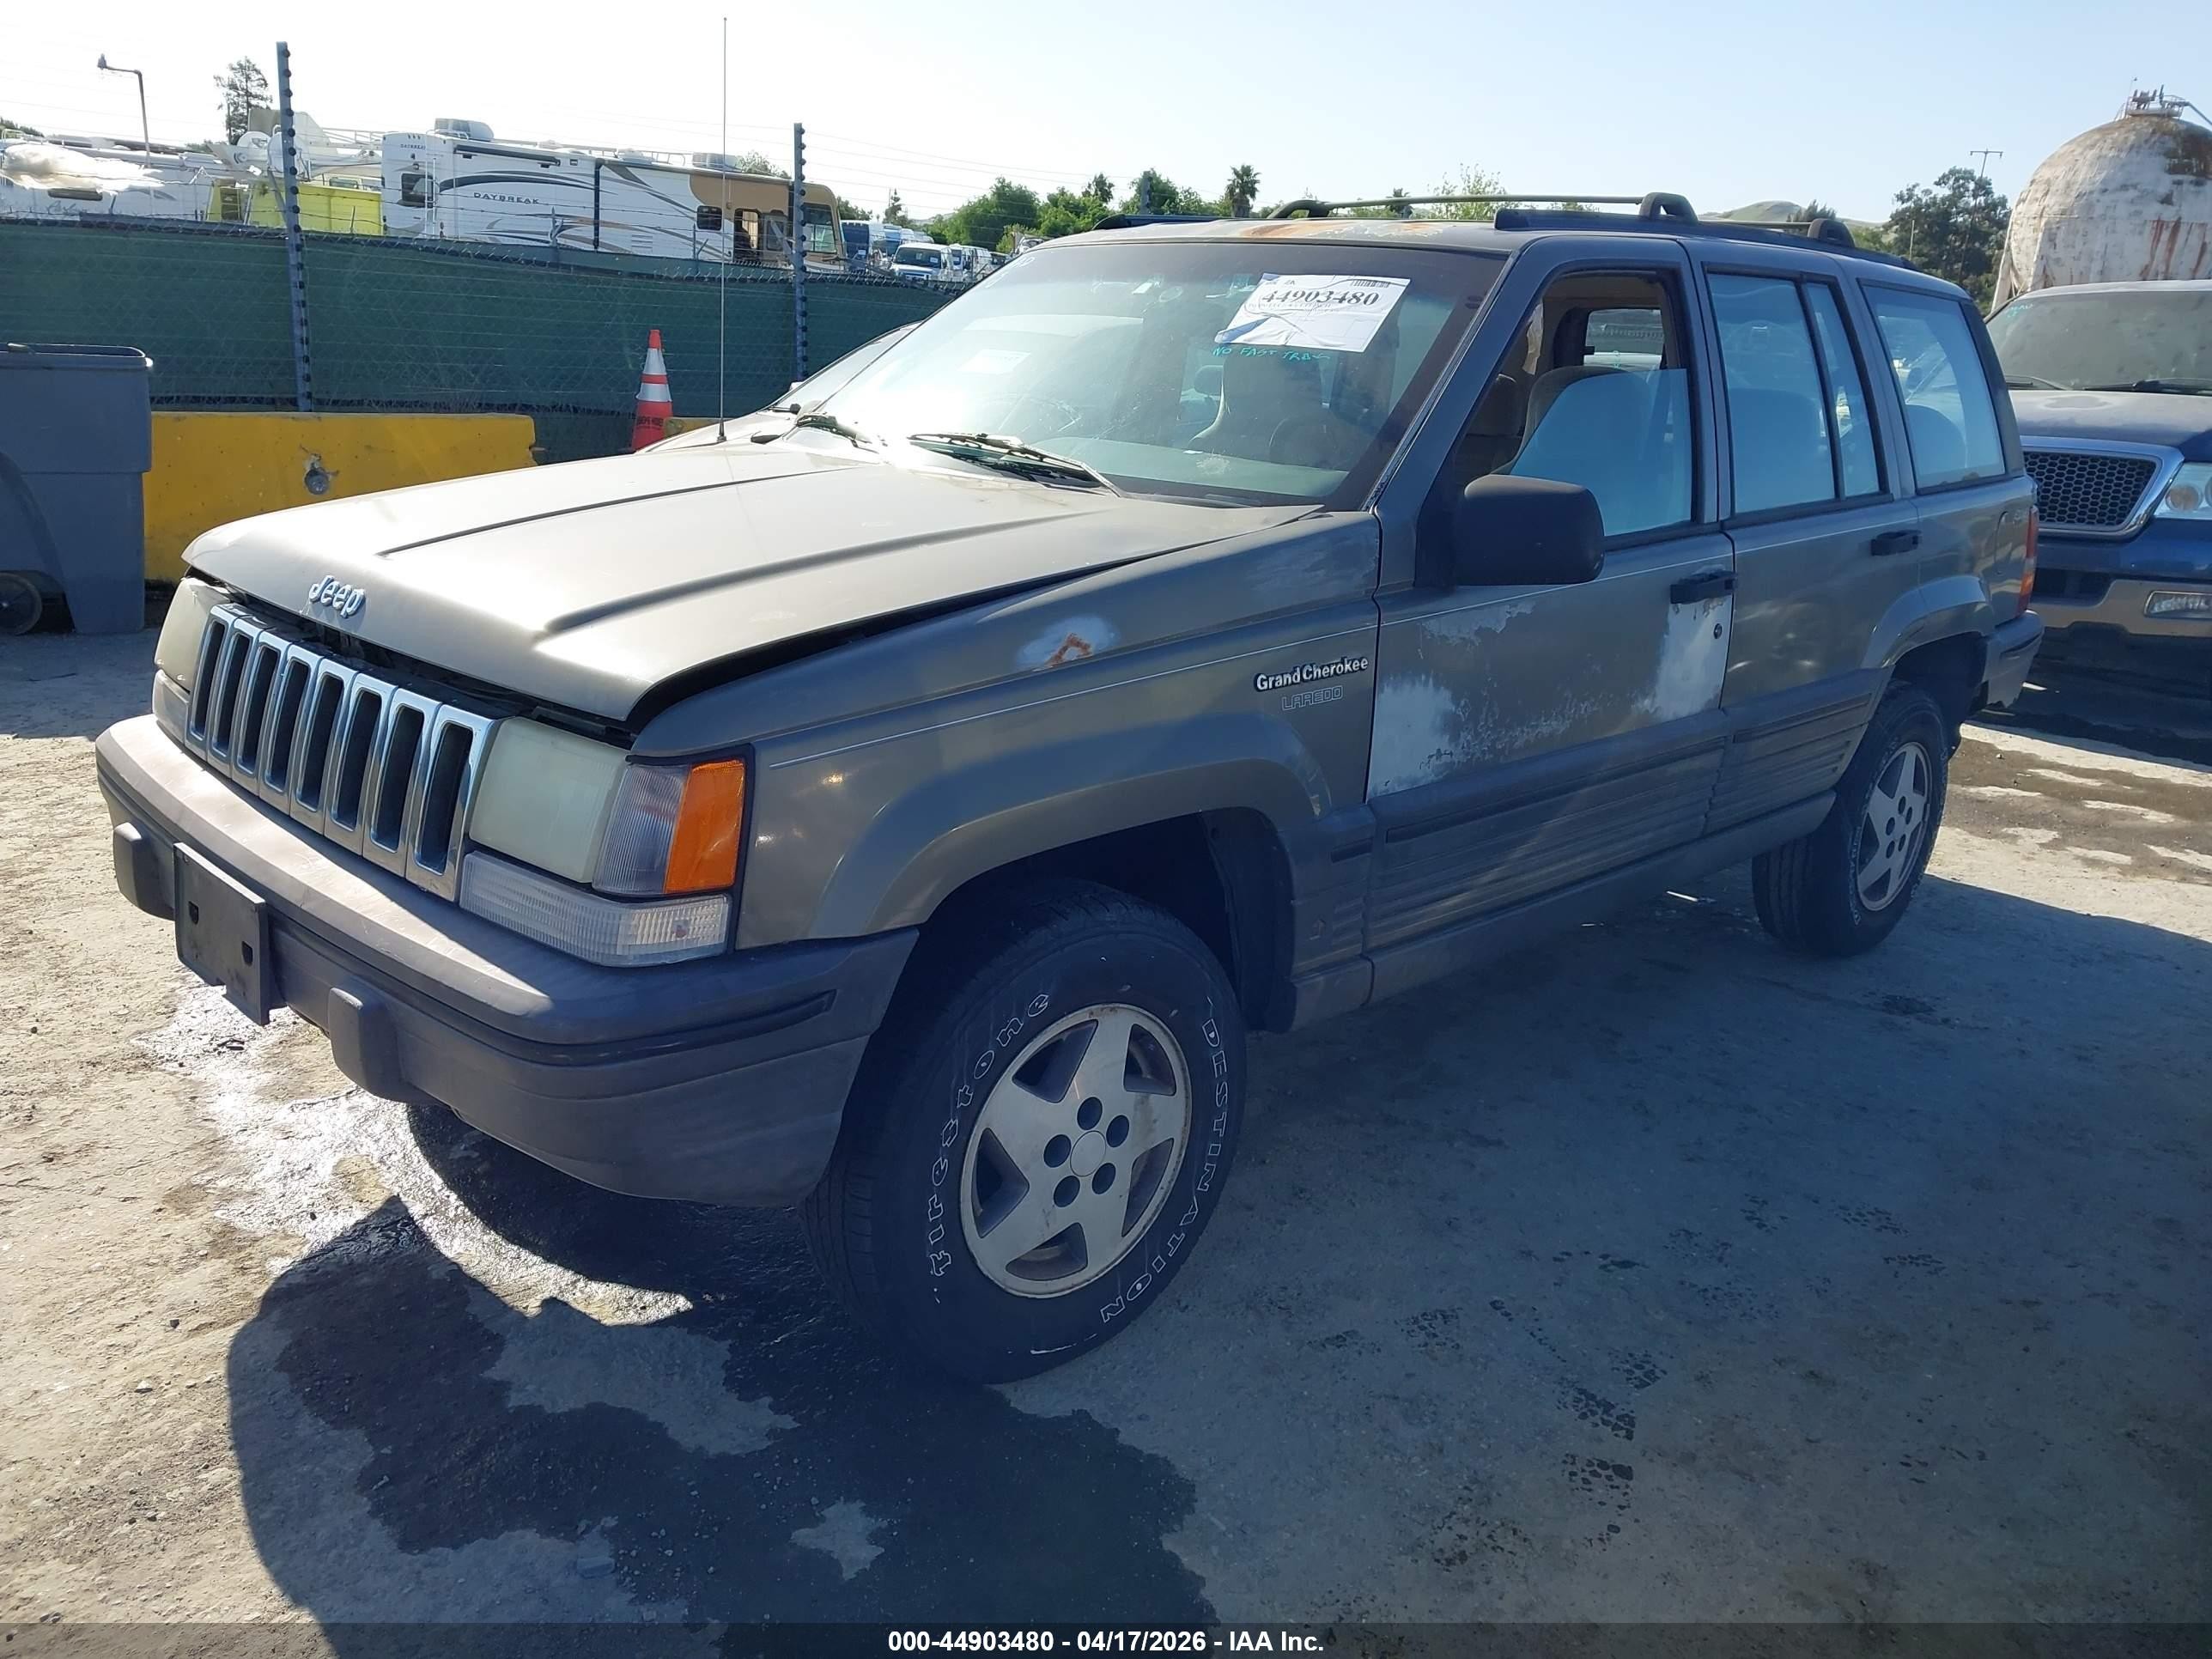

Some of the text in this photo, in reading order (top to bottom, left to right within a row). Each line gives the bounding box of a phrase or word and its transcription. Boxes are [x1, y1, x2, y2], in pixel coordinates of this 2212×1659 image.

[473, 192, 539, 205] DAYBREAK
[1261, 290, 1380, 307] 44903480
[1212, 346, 1232, 356] NO
[1240, 347, 1278, 356] FAST
[309, 574, 366, 618] Jeep
[1255, 657, 1369, 691] Grand Cherokee
[1281, 685, 1344, 711] LAREDO
[1100, 1018, 1229, 1323] DESTINATION
